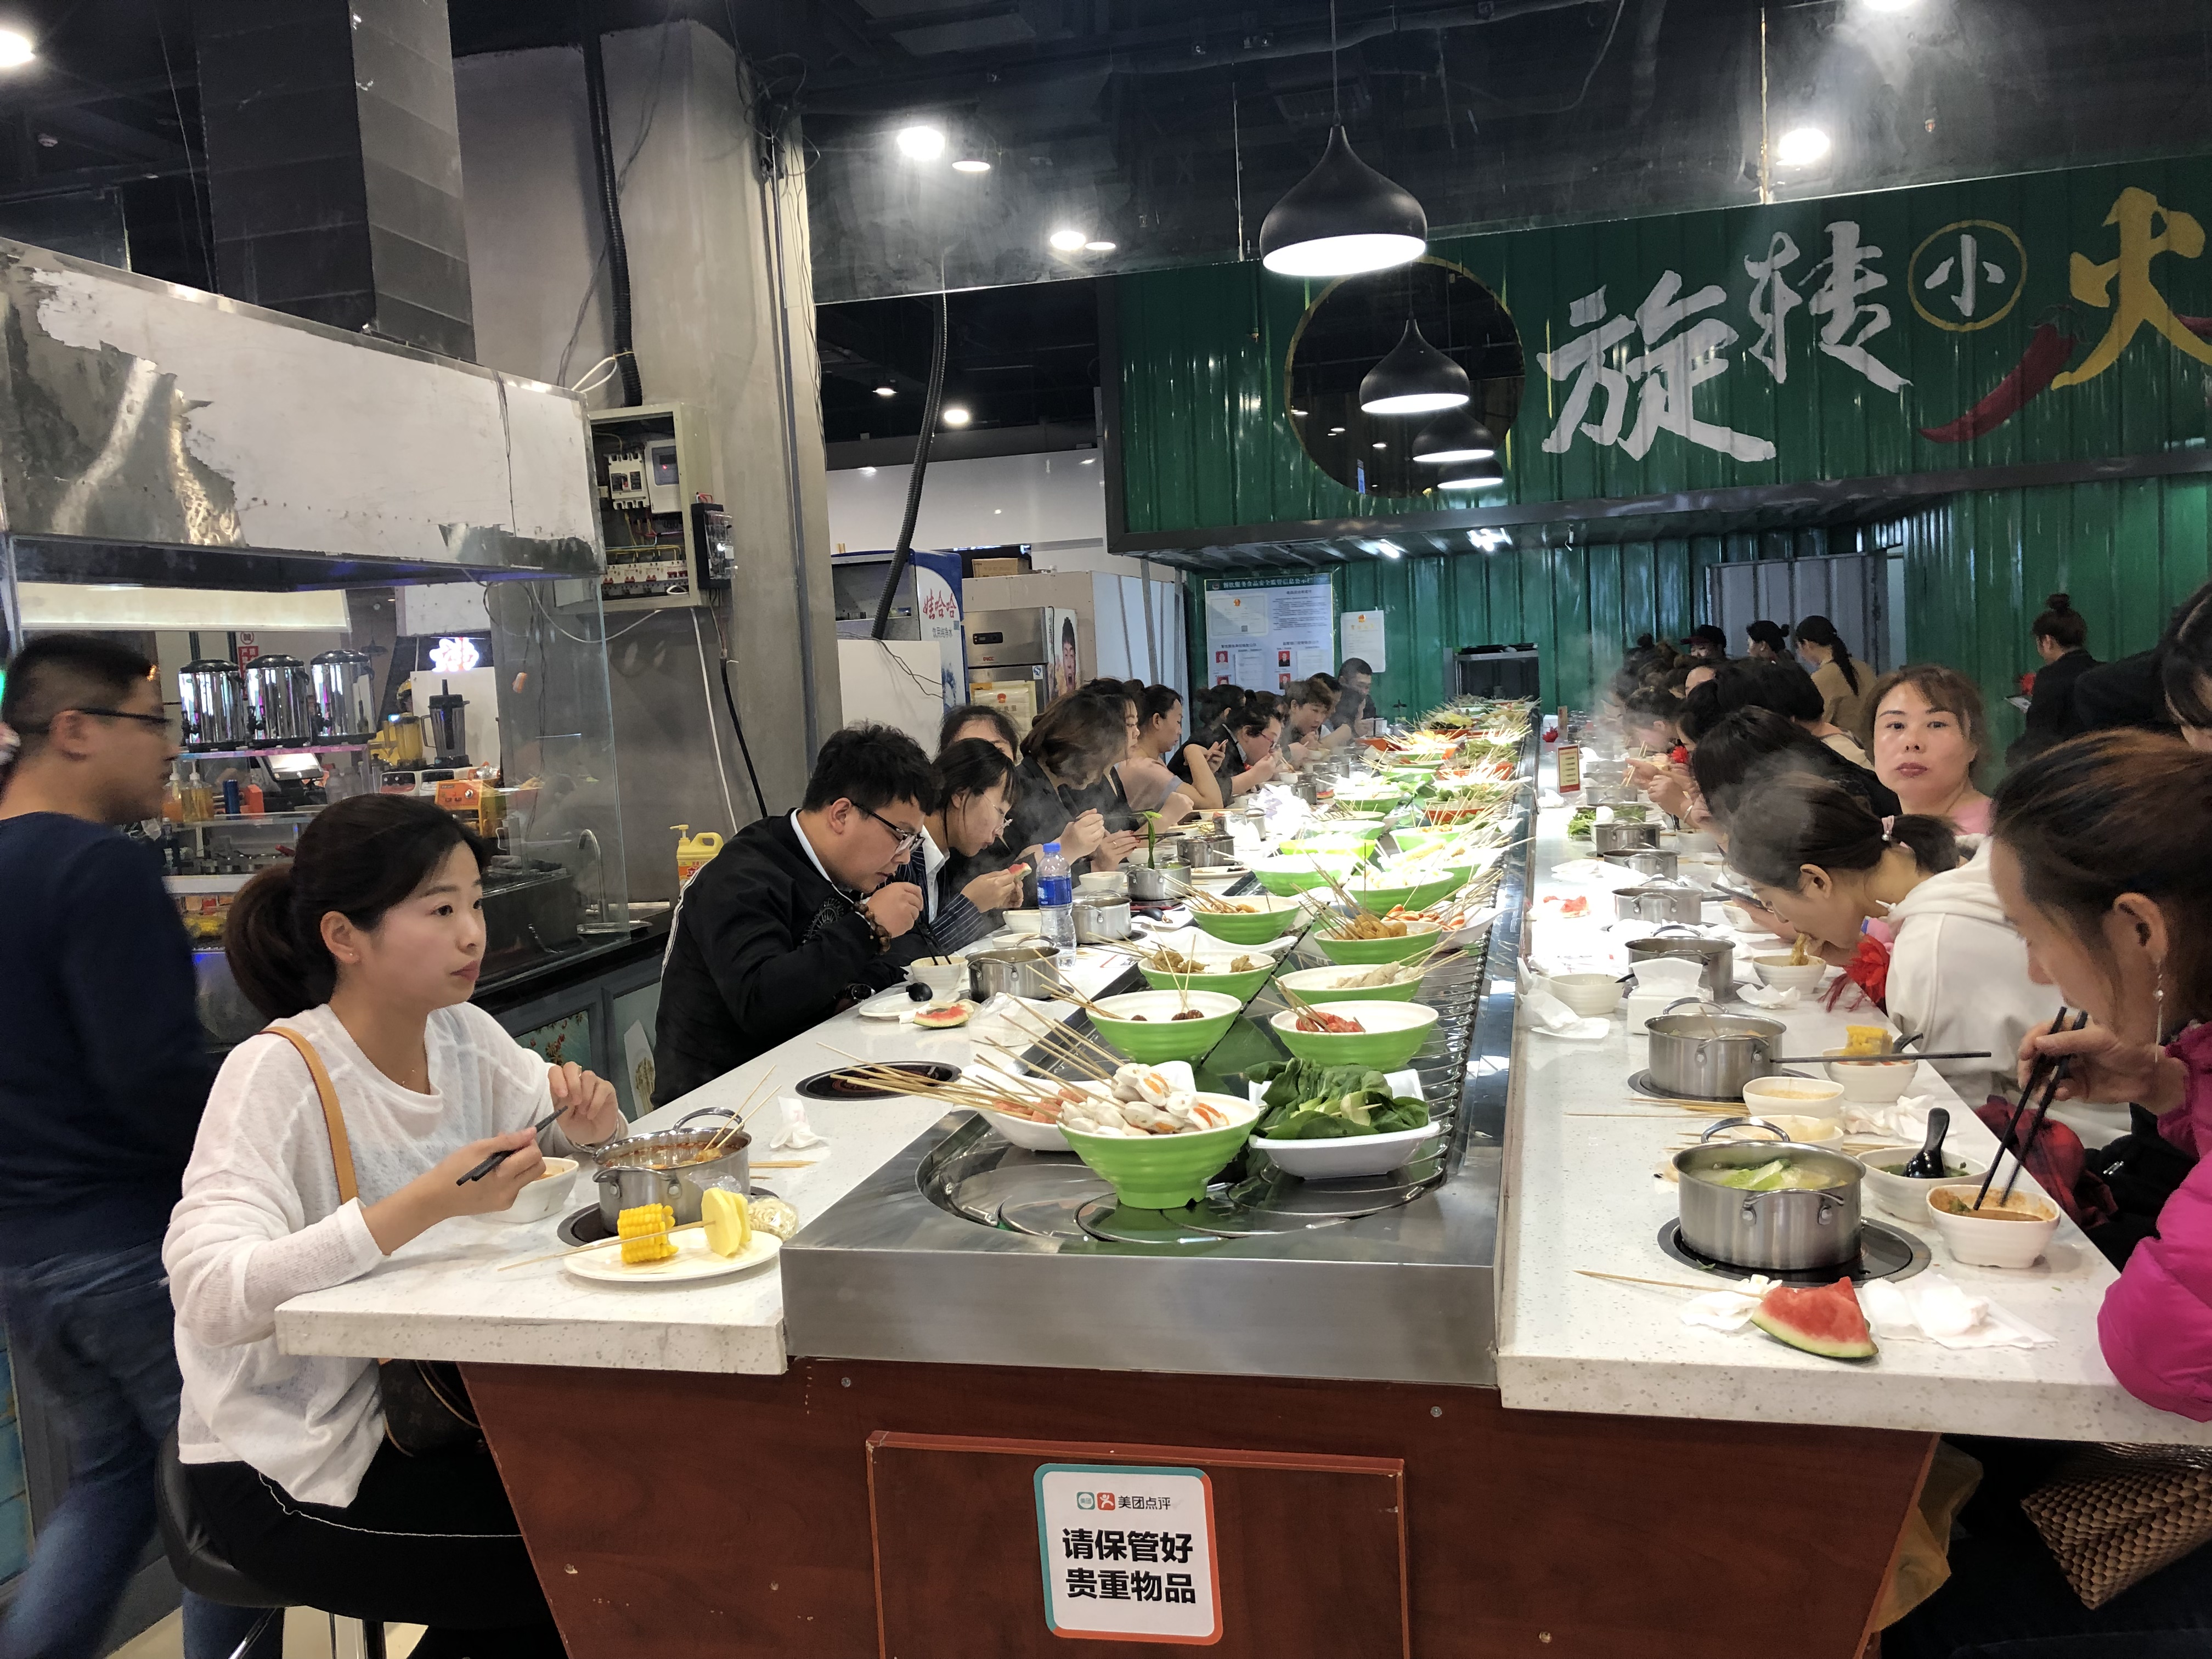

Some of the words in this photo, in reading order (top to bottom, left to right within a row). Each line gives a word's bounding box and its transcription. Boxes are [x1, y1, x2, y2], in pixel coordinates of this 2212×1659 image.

[923, 588, 956, 619] 娃哈哈
[1118, 1495, 1171, 1510] 美团点评
[1062, 1528, 1193, 1564] 请保管好
[1065, 1567, 1196, 1604] 贵重物品
